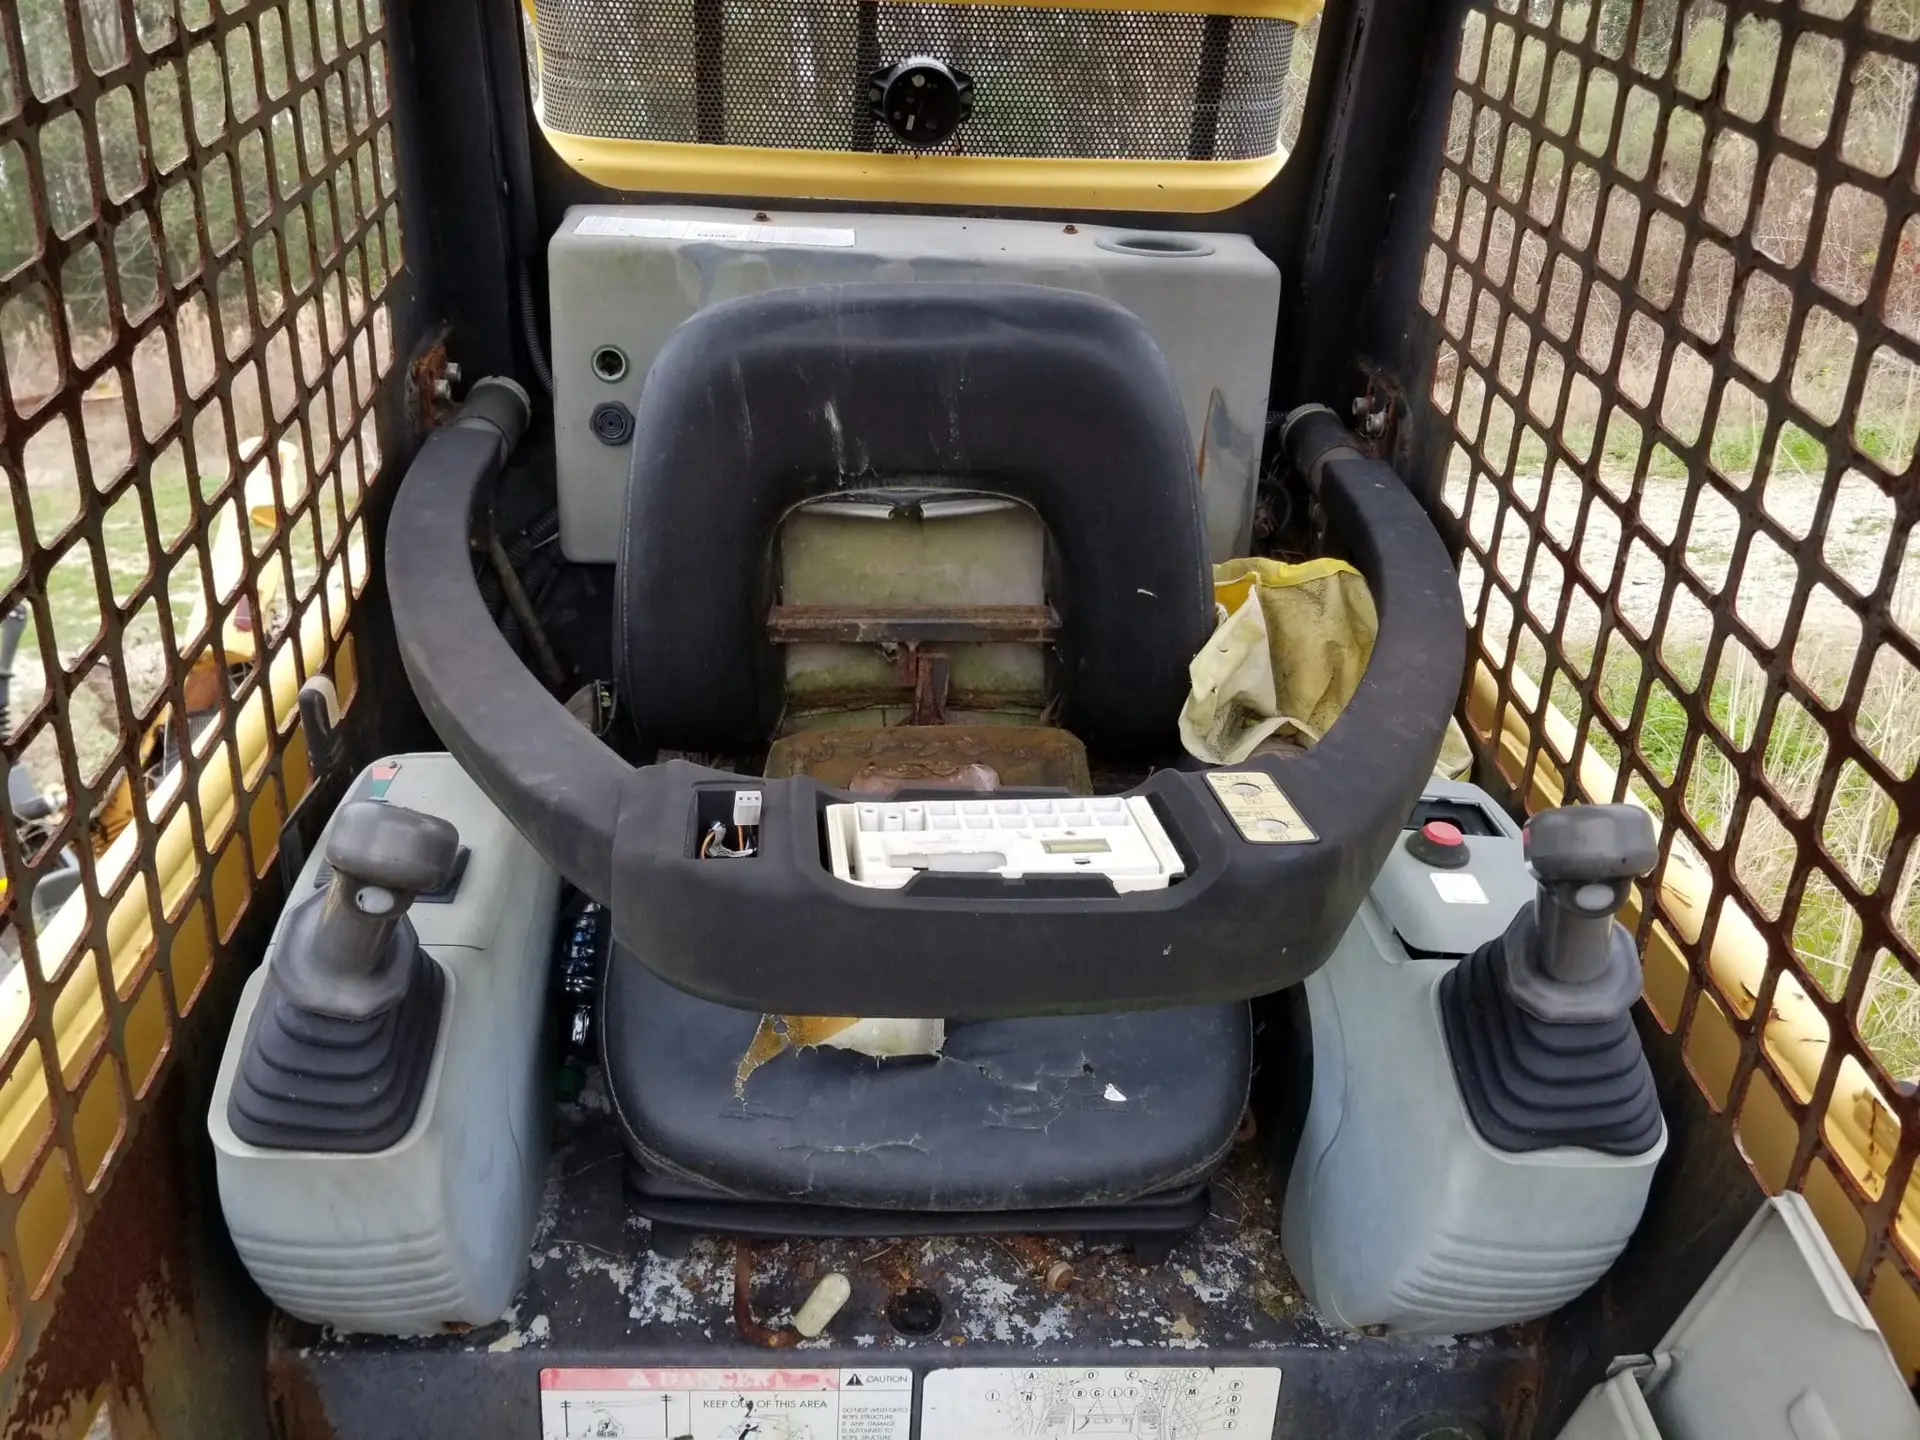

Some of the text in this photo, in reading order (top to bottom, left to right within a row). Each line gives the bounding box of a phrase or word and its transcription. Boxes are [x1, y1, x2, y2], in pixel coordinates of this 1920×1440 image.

[866, 1375, 908, 1383] CAUTION
[703, 1400, 828, 1408] KEEP OU OF THIS AREA
